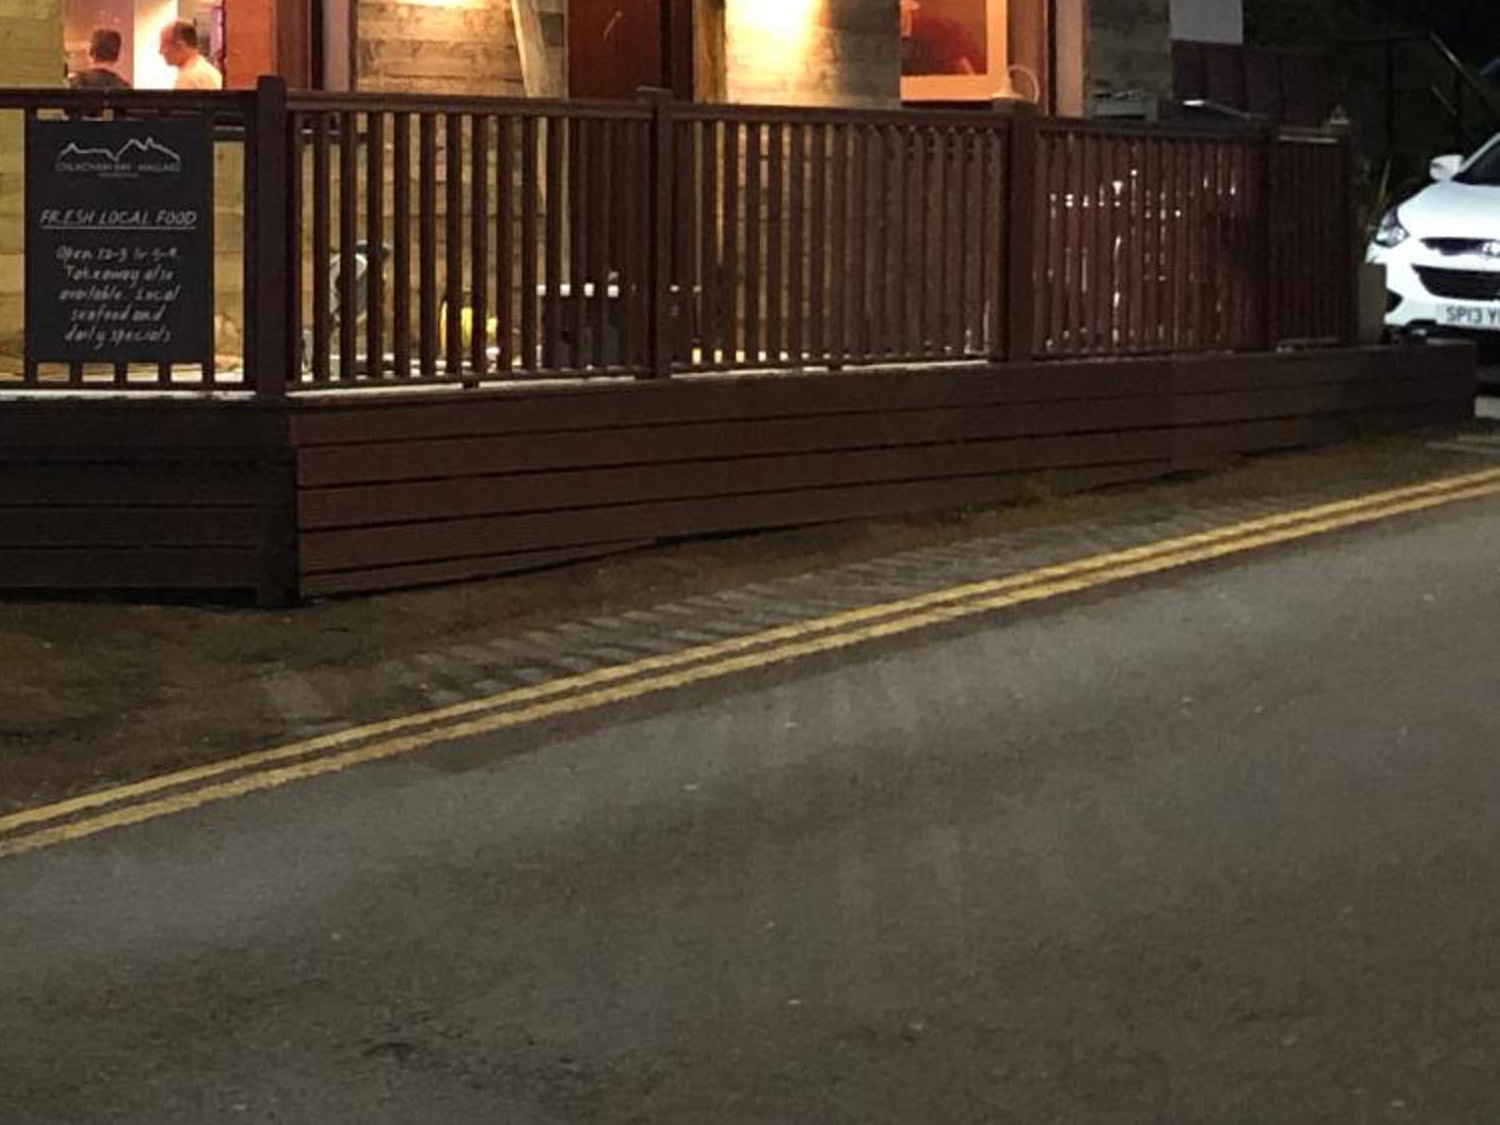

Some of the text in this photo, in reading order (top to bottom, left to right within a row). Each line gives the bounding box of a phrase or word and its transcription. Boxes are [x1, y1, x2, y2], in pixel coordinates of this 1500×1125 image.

[40, 208, 197, 225] FRESH LOCAL FOOD
[55, 243, 93, 263] Open
